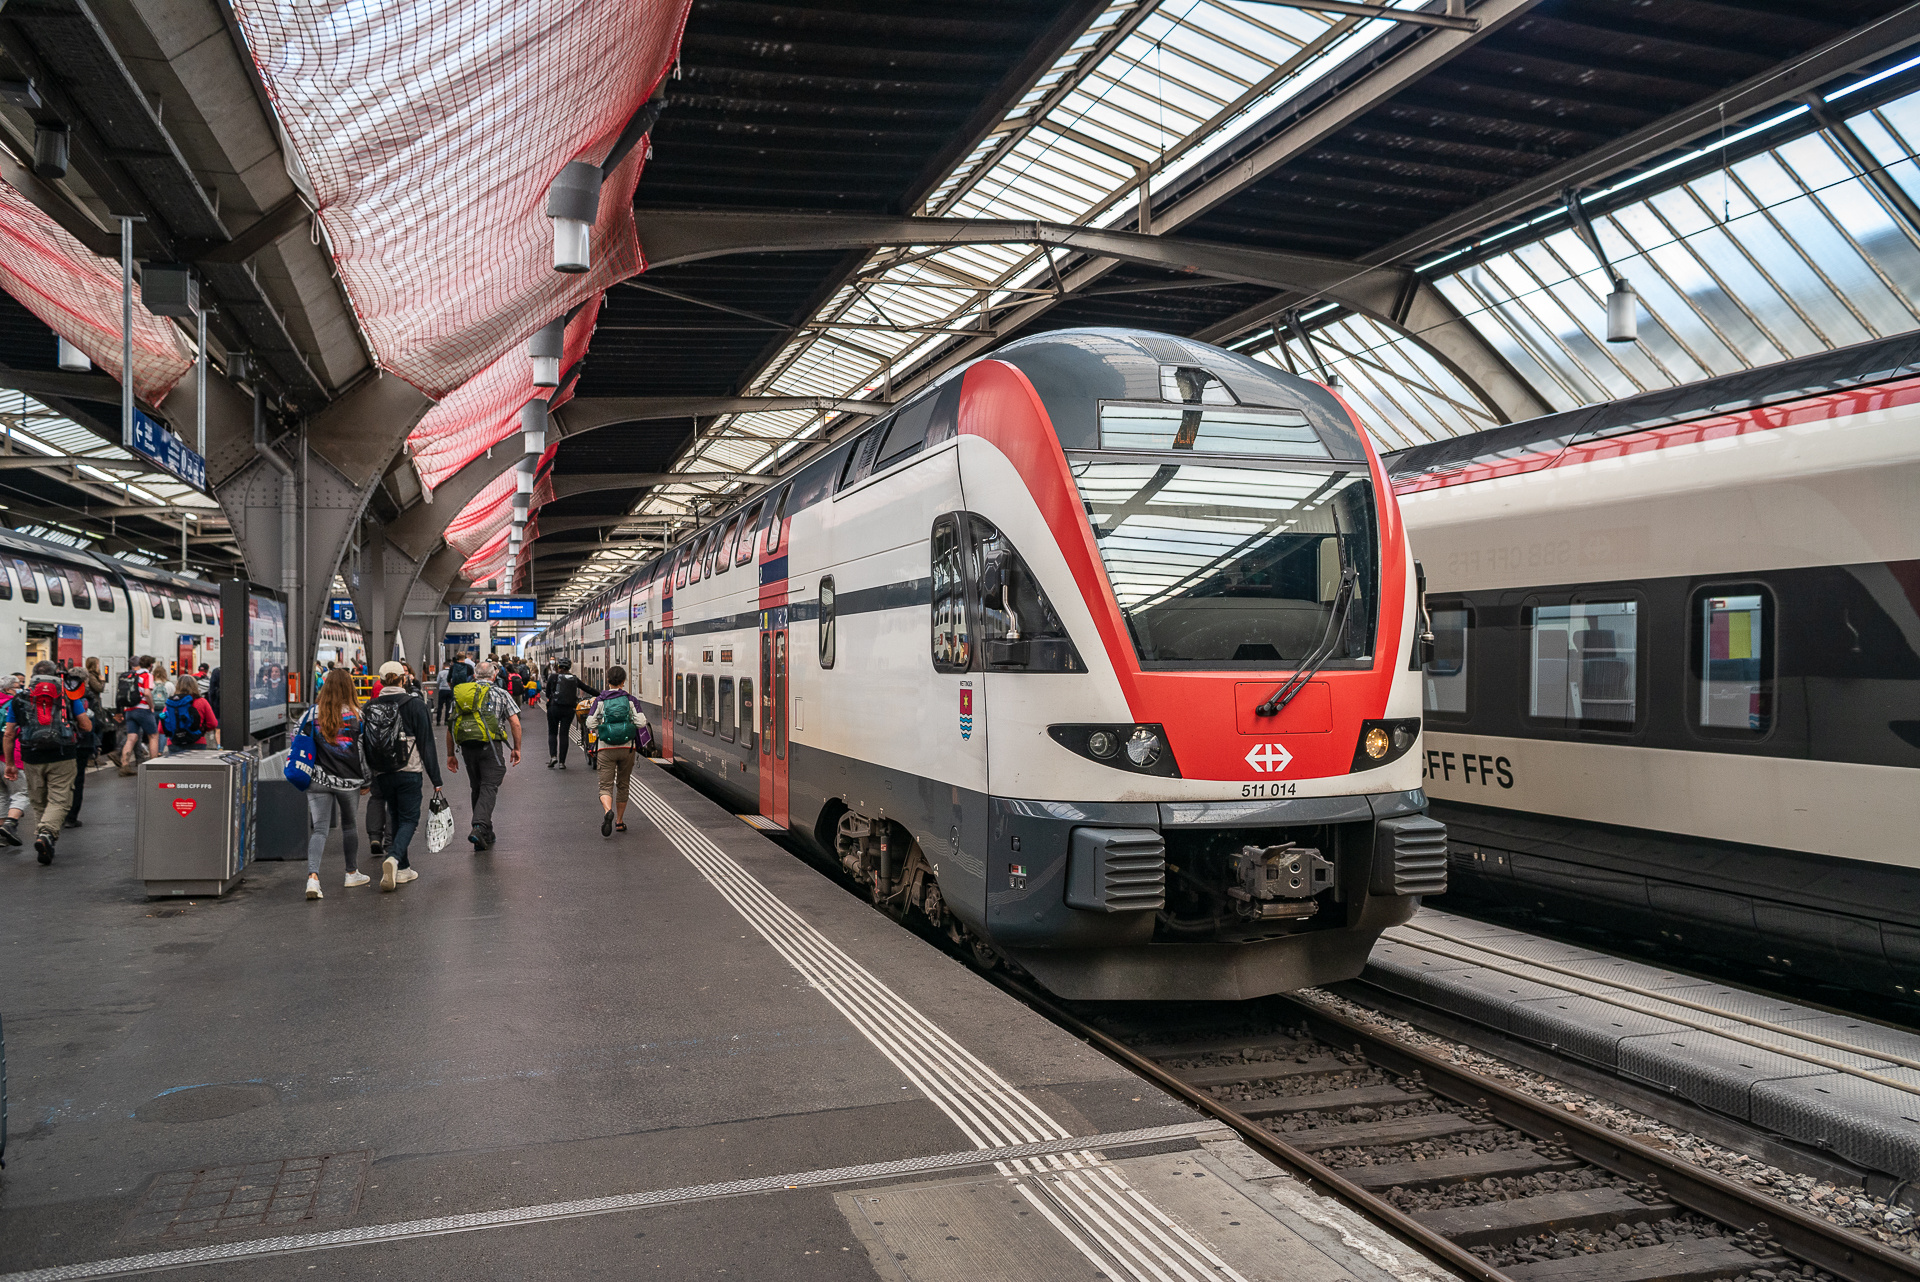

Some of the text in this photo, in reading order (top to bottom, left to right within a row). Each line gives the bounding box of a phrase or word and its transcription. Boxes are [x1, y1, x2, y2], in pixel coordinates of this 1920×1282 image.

[344, 610, 353, 620] 9
[454, 610, 463, 620] B
[474, 610, 482, 620] 8
[1462, 753, 1514, 789] FFS
[1241, 782, 1297, 797] 511 014
